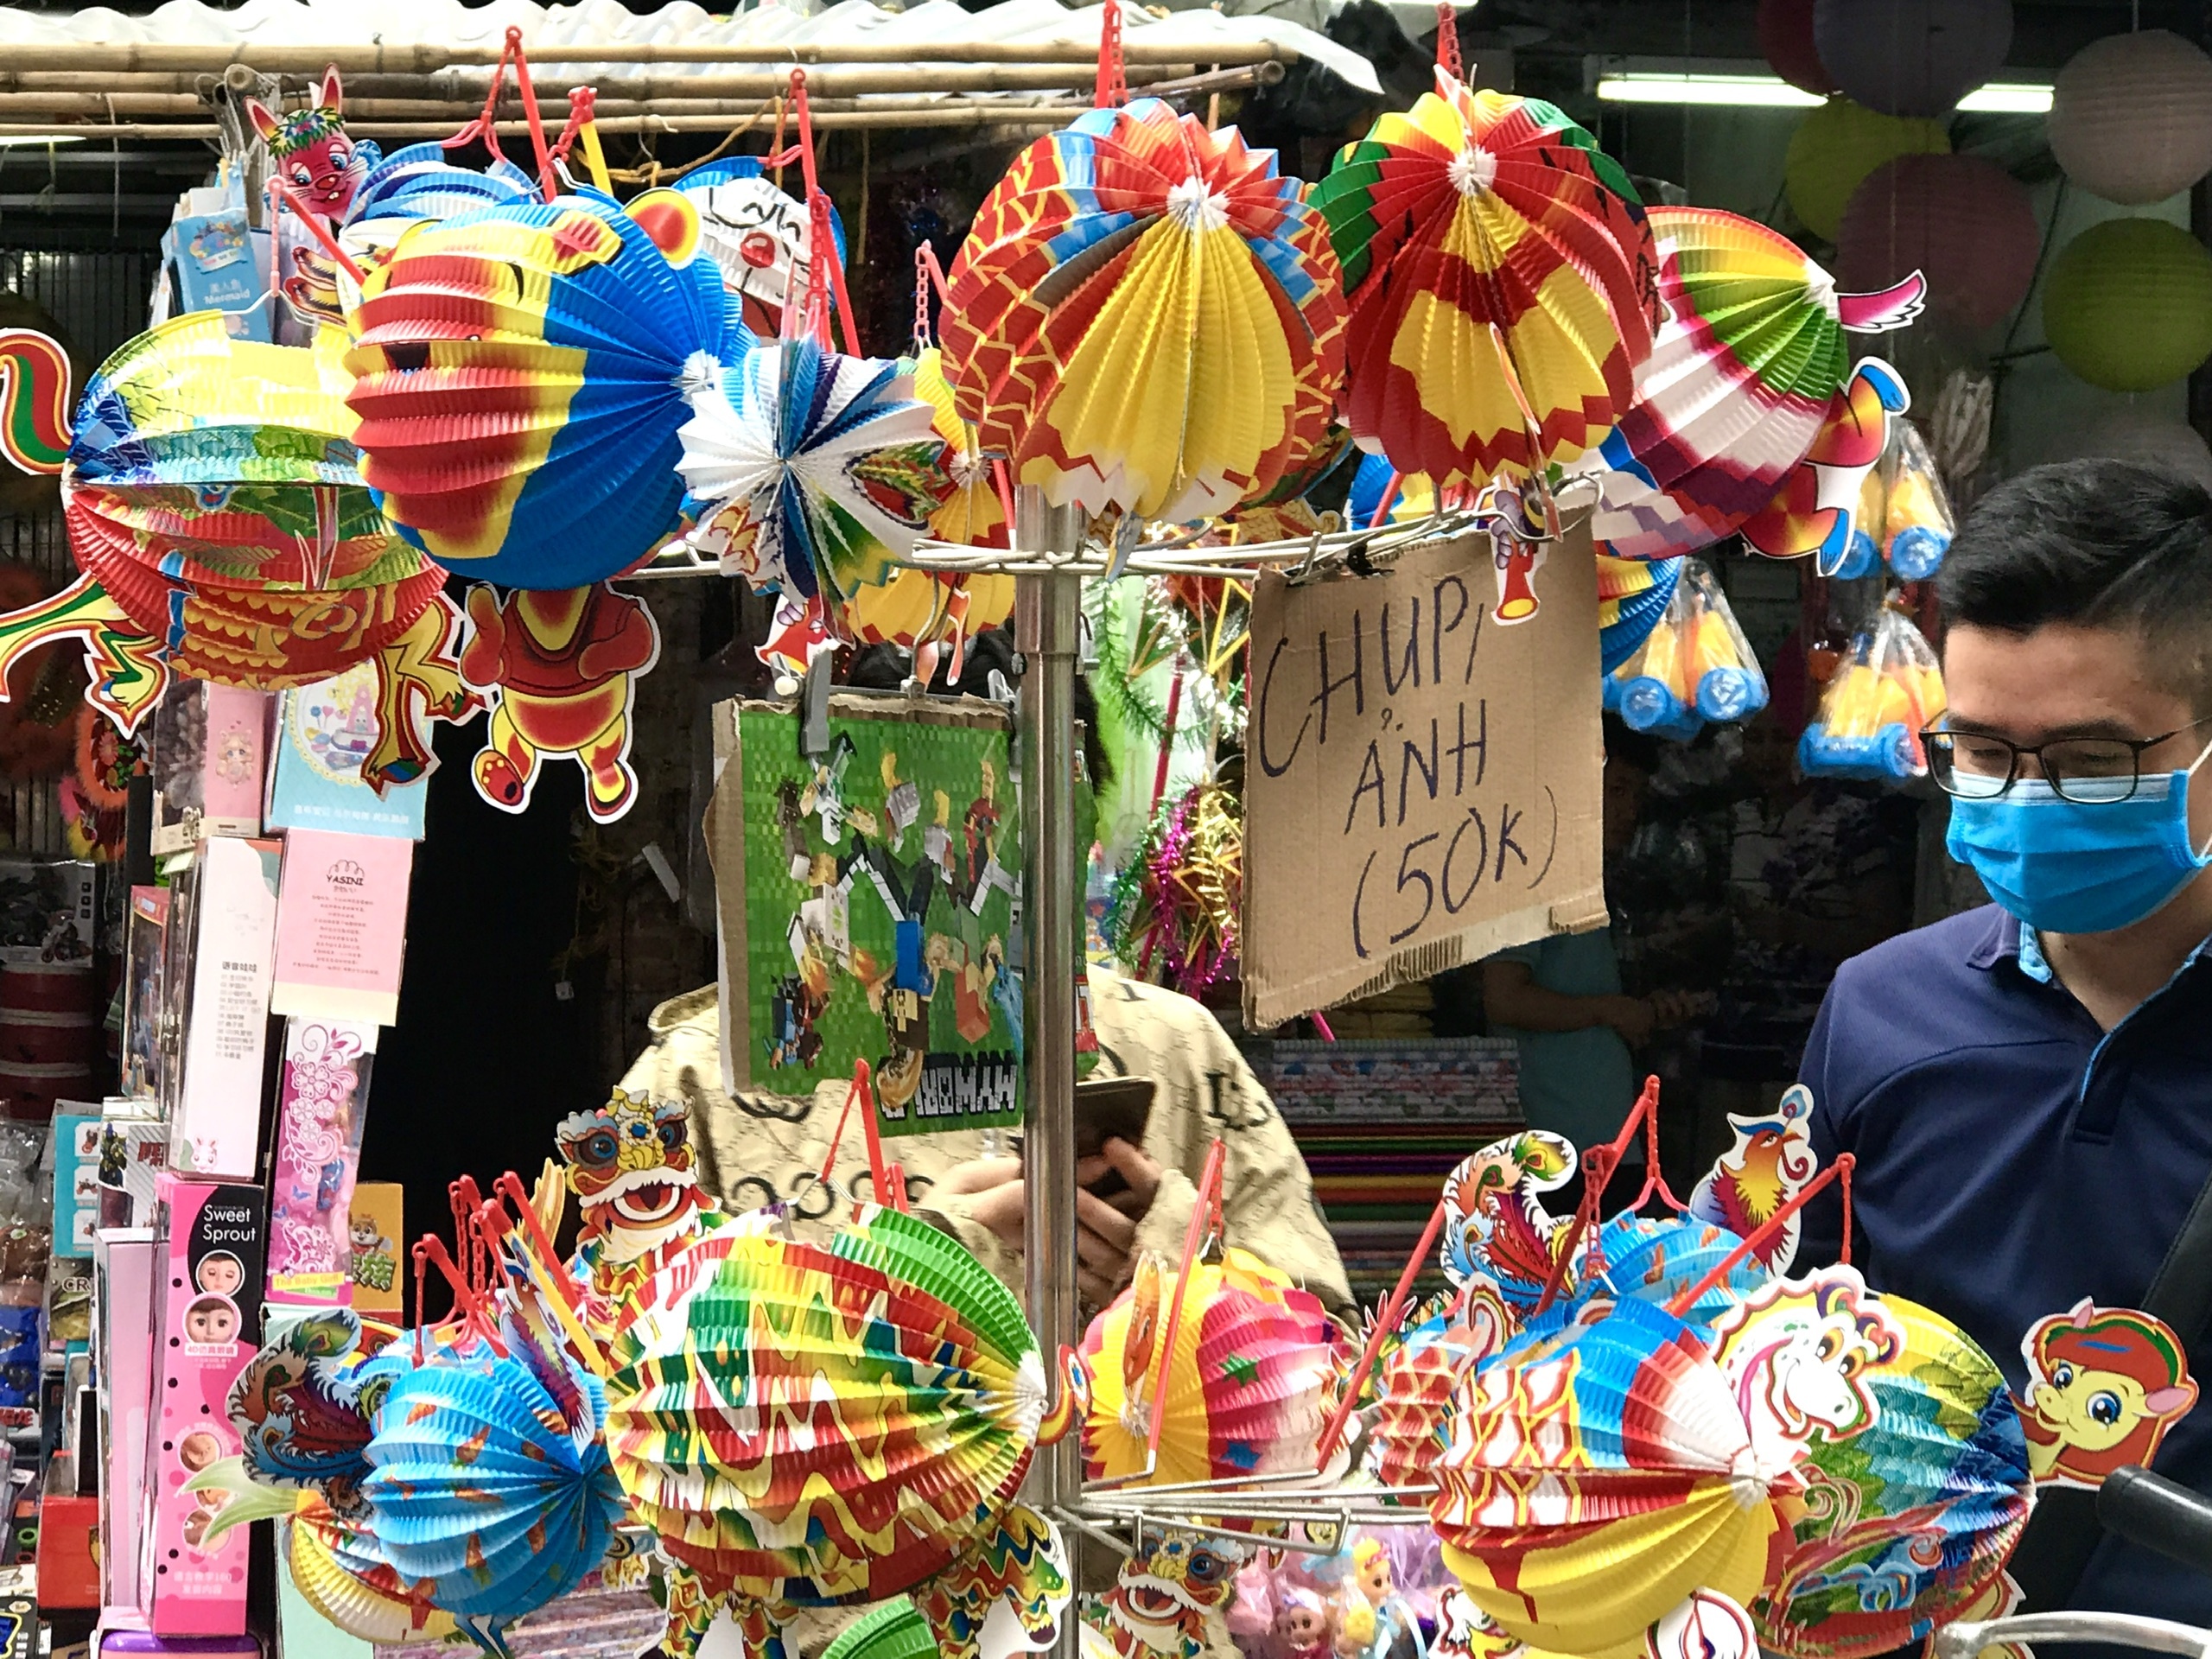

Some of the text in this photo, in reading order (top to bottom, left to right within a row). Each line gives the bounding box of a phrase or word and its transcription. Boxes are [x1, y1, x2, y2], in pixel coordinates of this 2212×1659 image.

[204, 289, 251, 305] Mermaid
[1351, 784, 1558, 959] (50K)
[326, 874, 364, 887] YASINI
[203, 1204, 251, 1223] Sweet
[202, 1223, 257, 1244] Sprout
[275, 1277, 293, 1287] The
[295, 1276, 318, 1286] Baby
